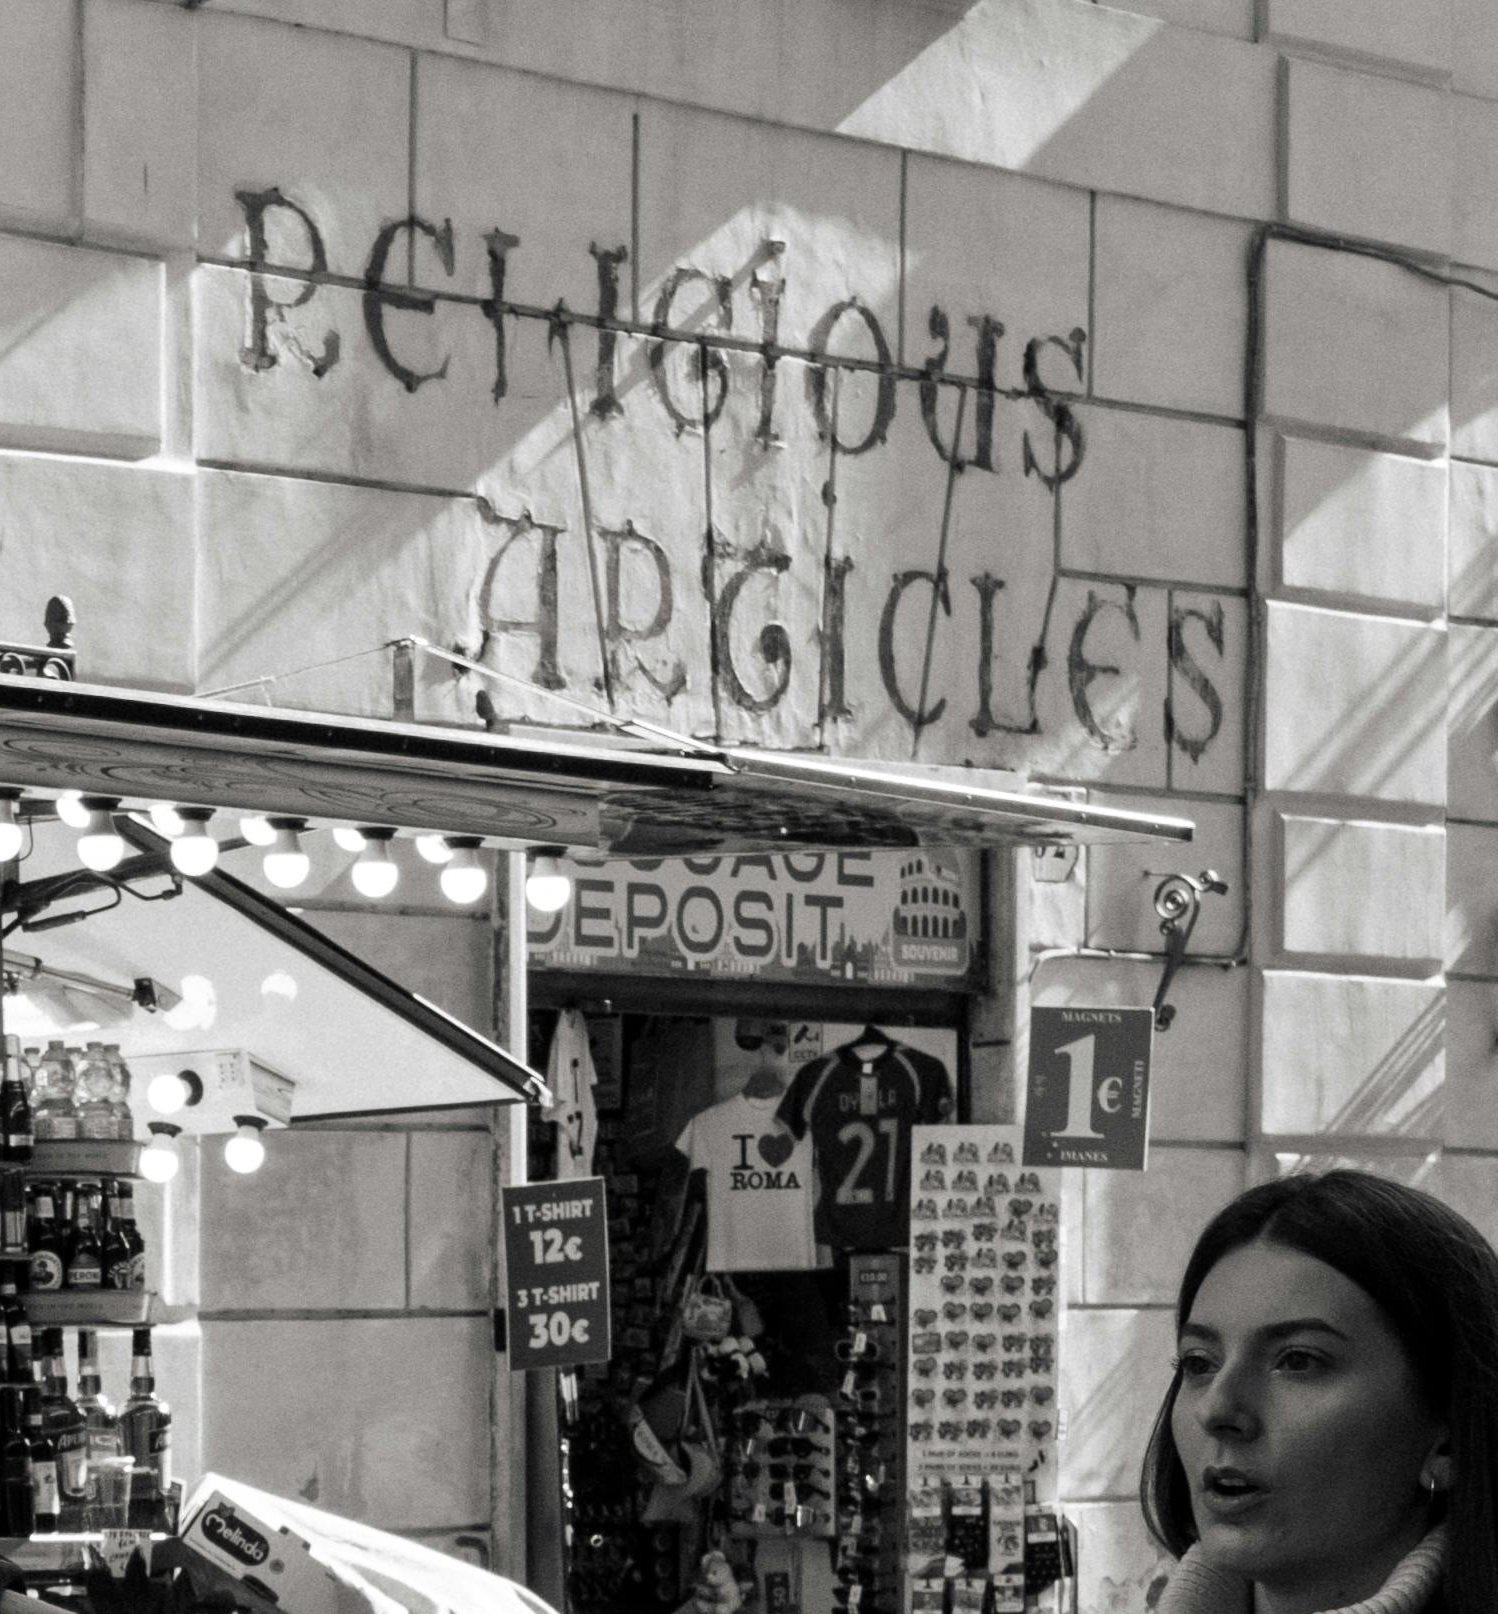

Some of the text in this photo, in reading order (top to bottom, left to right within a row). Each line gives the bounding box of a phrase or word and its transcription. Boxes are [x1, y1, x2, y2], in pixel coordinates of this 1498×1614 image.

[902, 946, 959, 963] SOUVENIR
[1061, 1010, 1122, 1023] MAGNETS
[1131, 1059, 1145, 1119] MAGNETI
[731, 1133, 755, 1171] I
[836, 1117, 899, 1205] 21
[1061, 1151, 1109, 1162] IMANES
[730, 1171, 801, 1191] ROMA
[512, 1199, 594, 1225] 1 T-SHIRT
[529, 1228, 582, 1265] 12€
[517, 1281, 601, 1308] 3 T-SHIRT
[528, 1311, 590, 1350] 30€
[205, 1512, 264, 1561] Melinda
